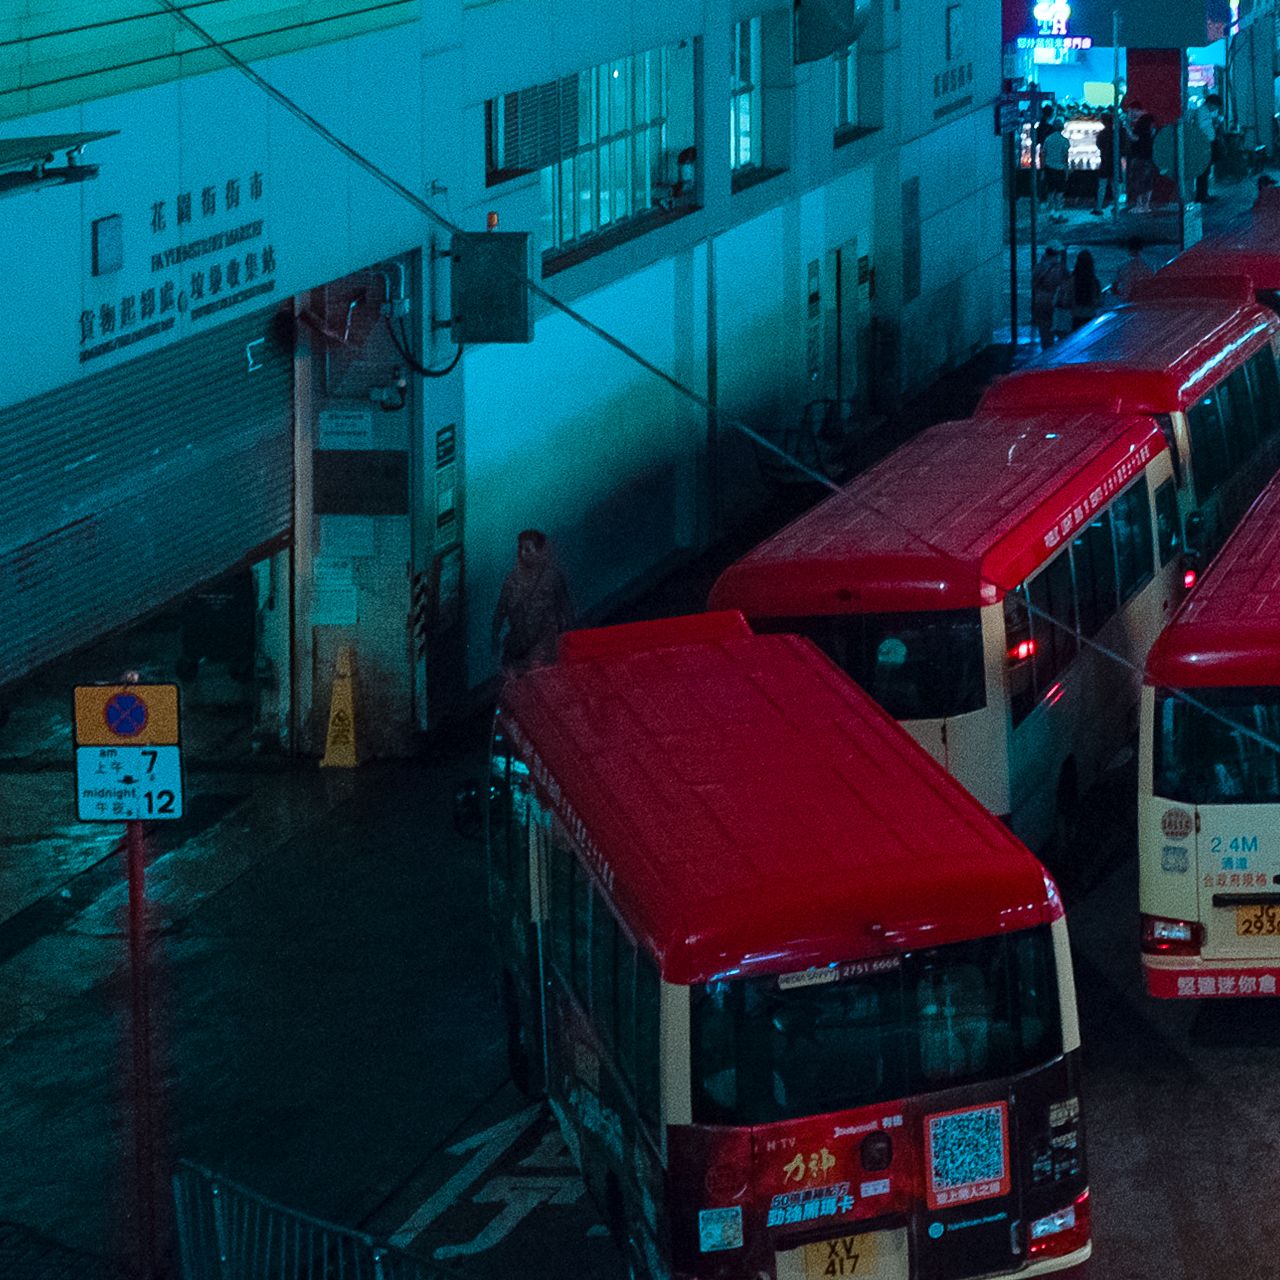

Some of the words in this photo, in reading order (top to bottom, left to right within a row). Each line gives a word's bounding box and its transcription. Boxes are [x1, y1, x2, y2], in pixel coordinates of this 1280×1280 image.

[95, 760, 123, 775] 上午
[100, 749, 118, 758] am
[141, 750, 158, 774] 7
[83, 787, 137, 800] midnight
[144, 789, 175, 815] 12
[1210, 835, 1259, 853] 2.4M
[826, 1237, 855, 1260] XV
[824, 1254, 860, 1277] 417
